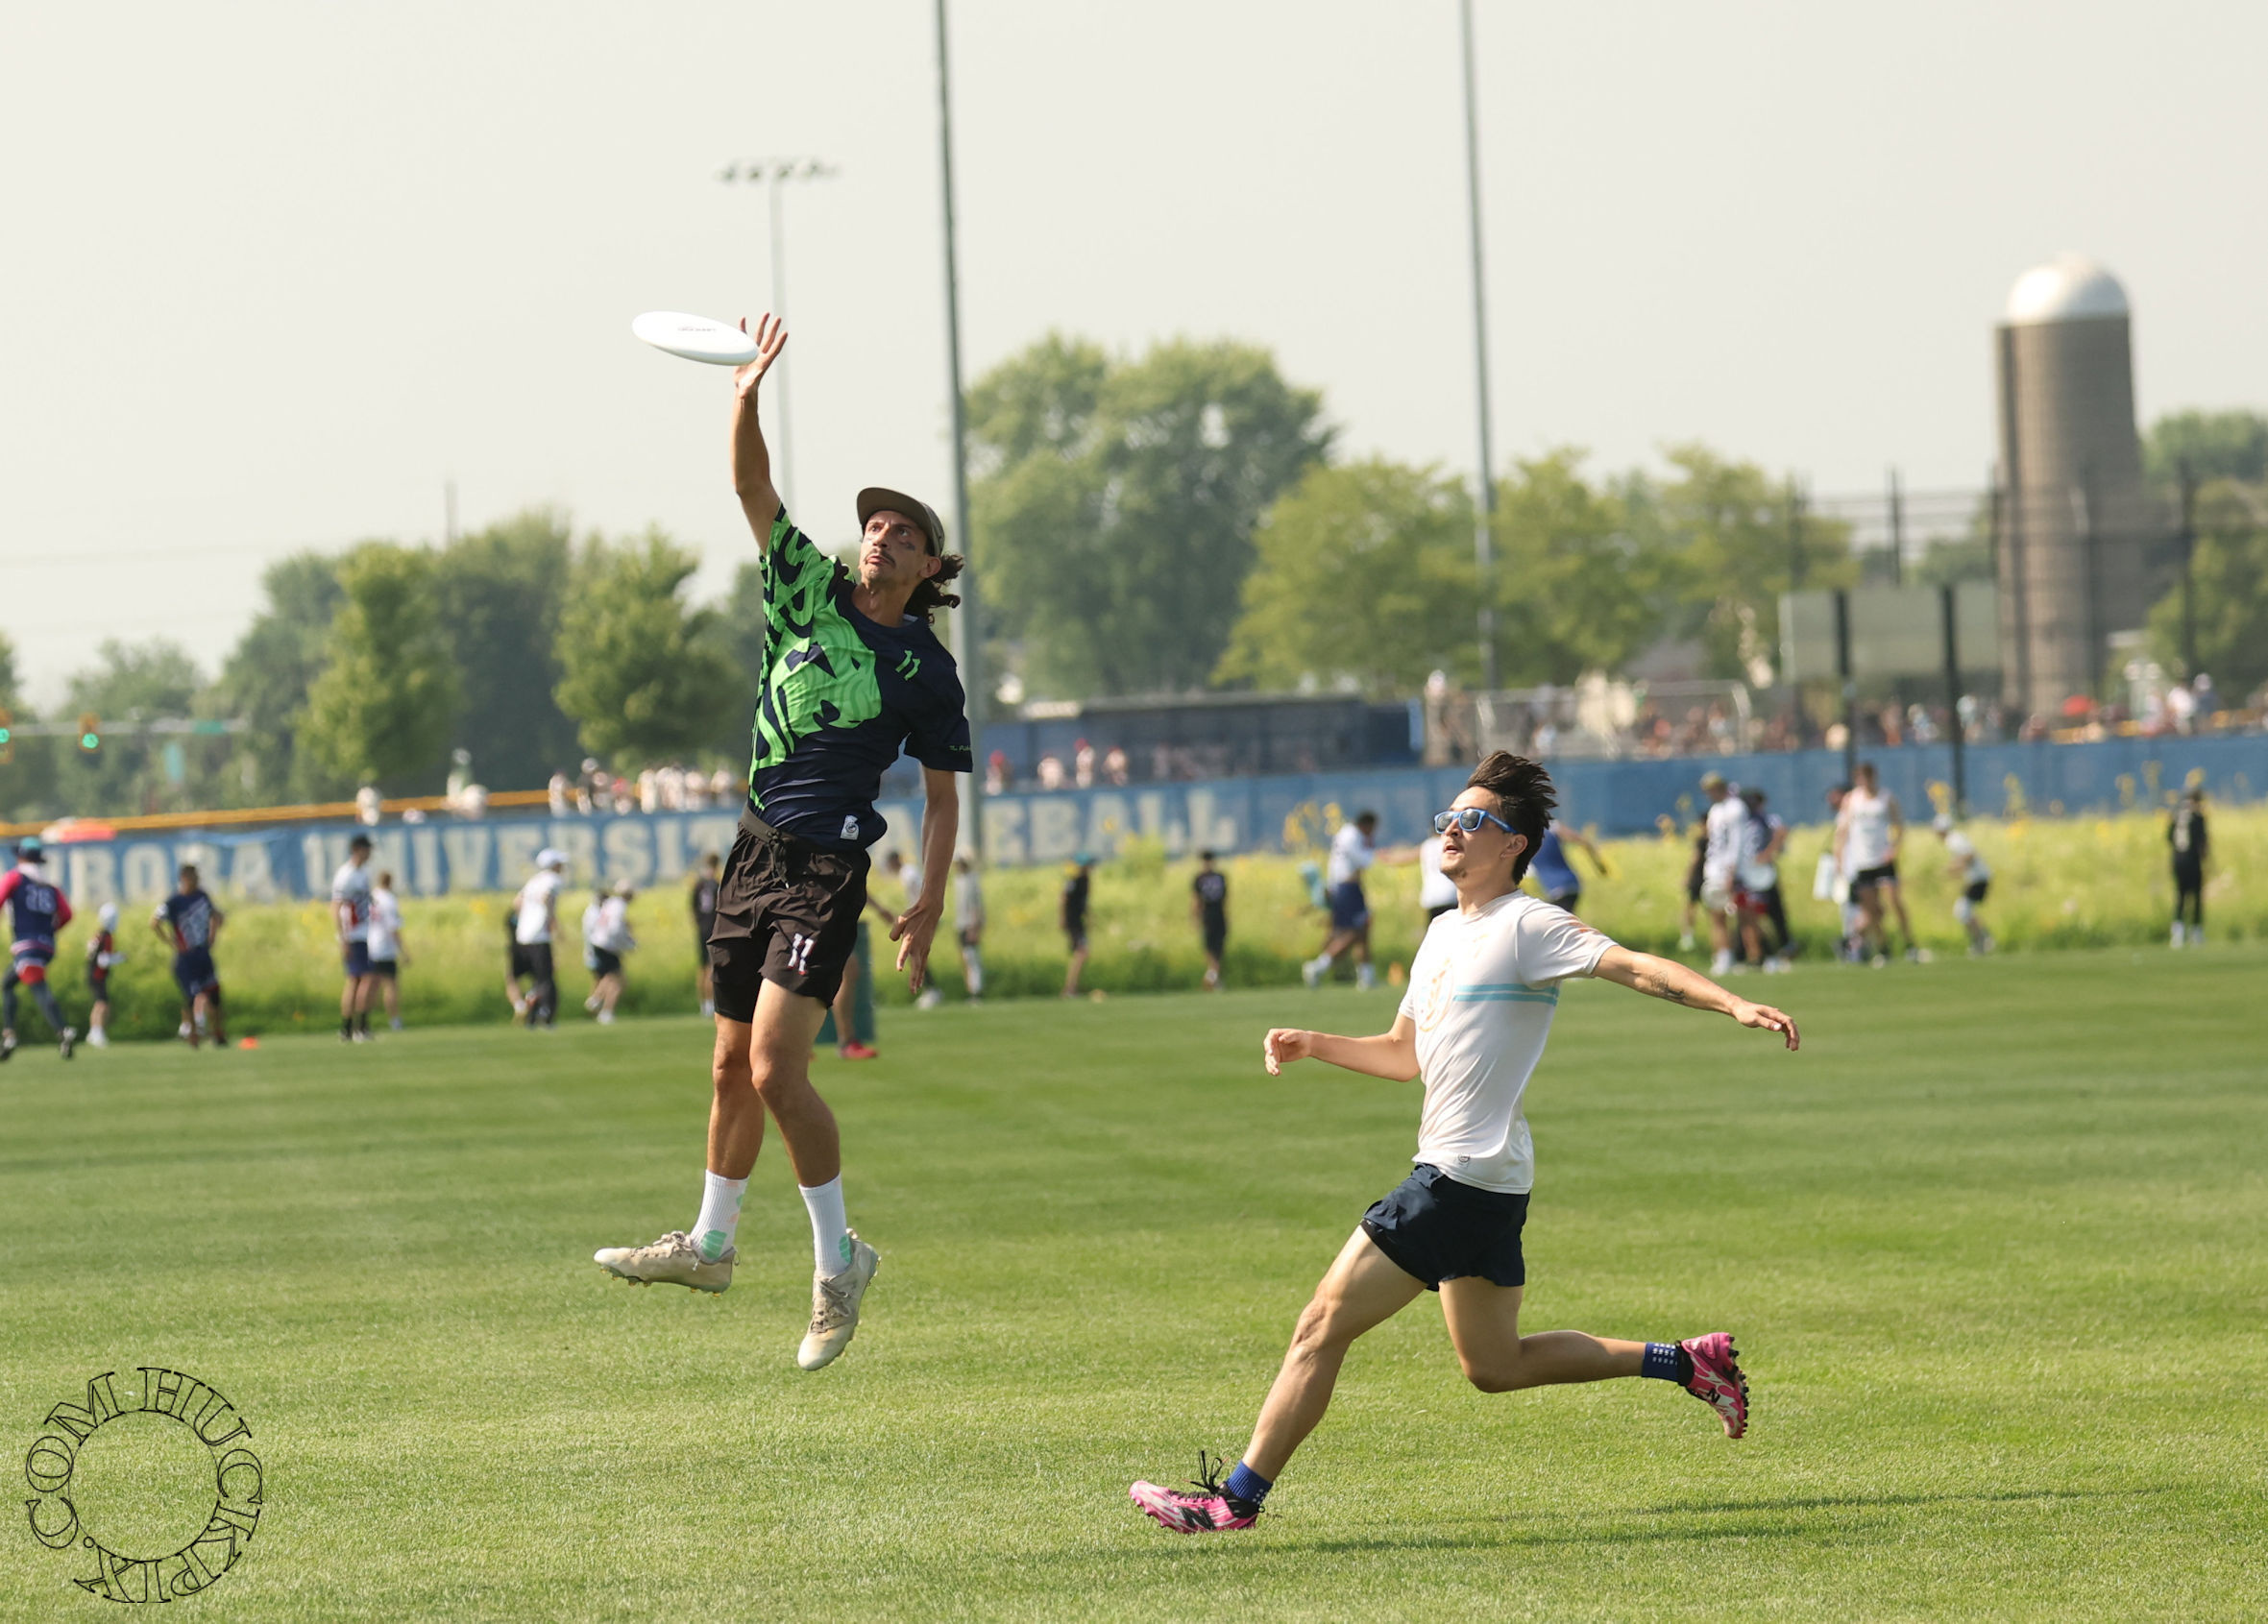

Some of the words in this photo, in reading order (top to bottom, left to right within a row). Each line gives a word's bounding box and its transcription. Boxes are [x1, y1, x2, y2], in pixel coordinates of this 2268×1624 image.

[894, 649, 921, 681] 11
[301, 817, 743, 899] UNIVERSIT
[788, 933, 816, 975] 11
